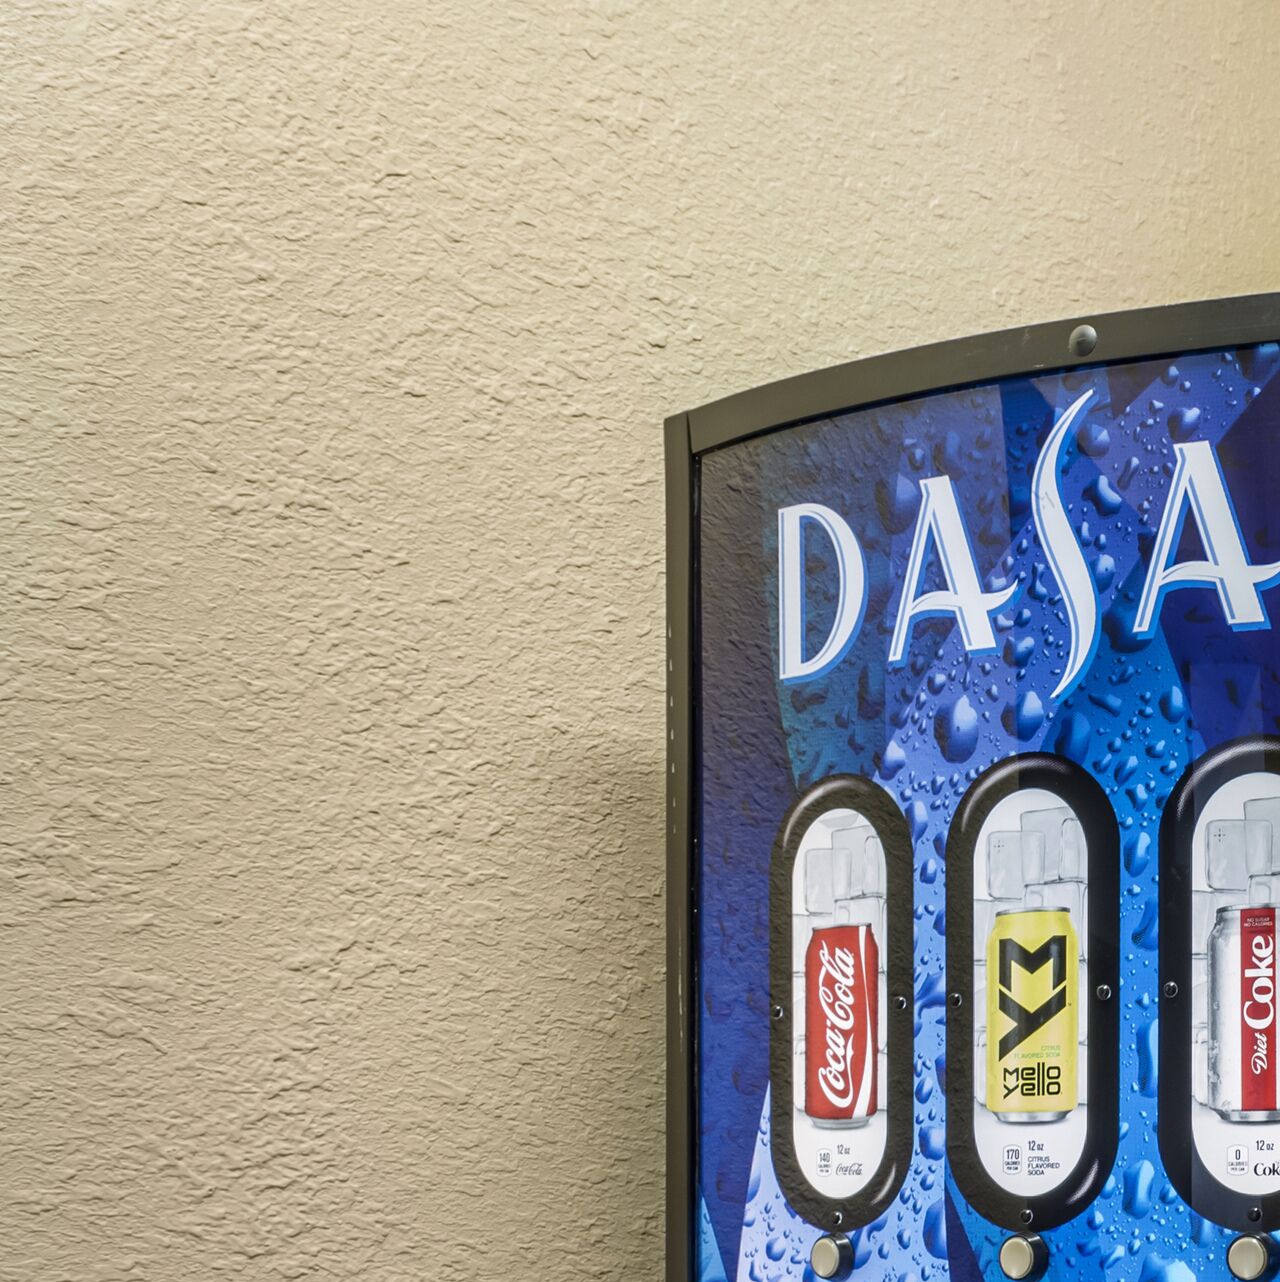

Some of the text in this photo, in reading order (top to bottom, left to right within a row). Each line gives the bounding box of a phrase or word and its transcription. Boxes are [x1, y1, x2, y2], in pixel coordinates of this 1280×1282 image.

[817, 938, 856, 1109] Coca-Cola
[1243, 934, 1275, 1075] Diet Coke
[1006, 1149, 1020, 1160] 170
